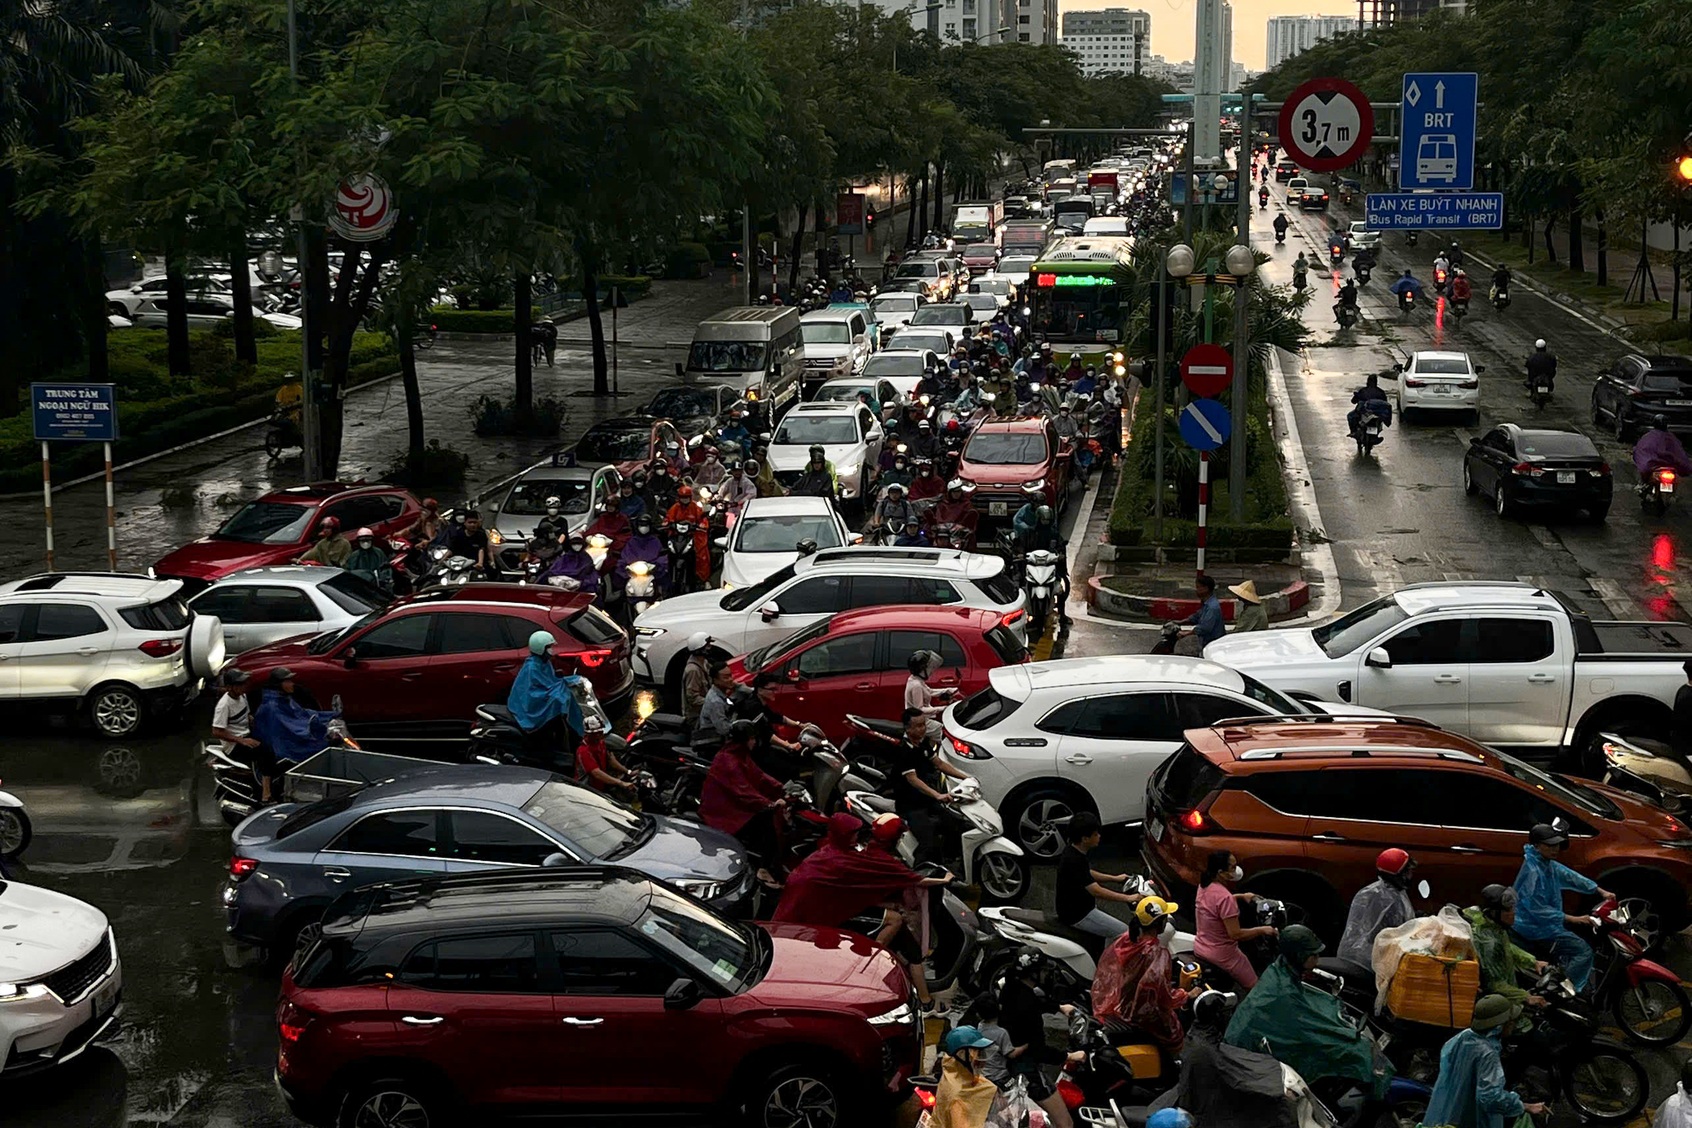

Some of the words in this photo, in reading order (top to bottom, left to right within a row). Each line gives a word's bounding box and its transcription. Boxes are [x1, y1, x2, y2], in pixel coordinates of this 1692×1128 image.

[1424, 113, 1454, 128] BRT
[1337, 127, 1350, 141] m
[1370, 196, 1397, 211] LÀN
[1400, 198, 1415, 211] XE
[1420, 196, 1451, 210] BUÝT
[1456, 198, 1498, 211] NHANH
[1369, 214, 1390, 225] Bus
[1394, 214, 1422, 226] Rapid
[1426, 213, 1460, 225] Transit
[1468, 213, 1497, 225] (BRT)
[45, 389, 77, 398] TRUNG
[78, 388, 99, 399] TÂM
[38, 401, 69, 412] NGOẠI
[70, 400, 91, 410] NGỮ
